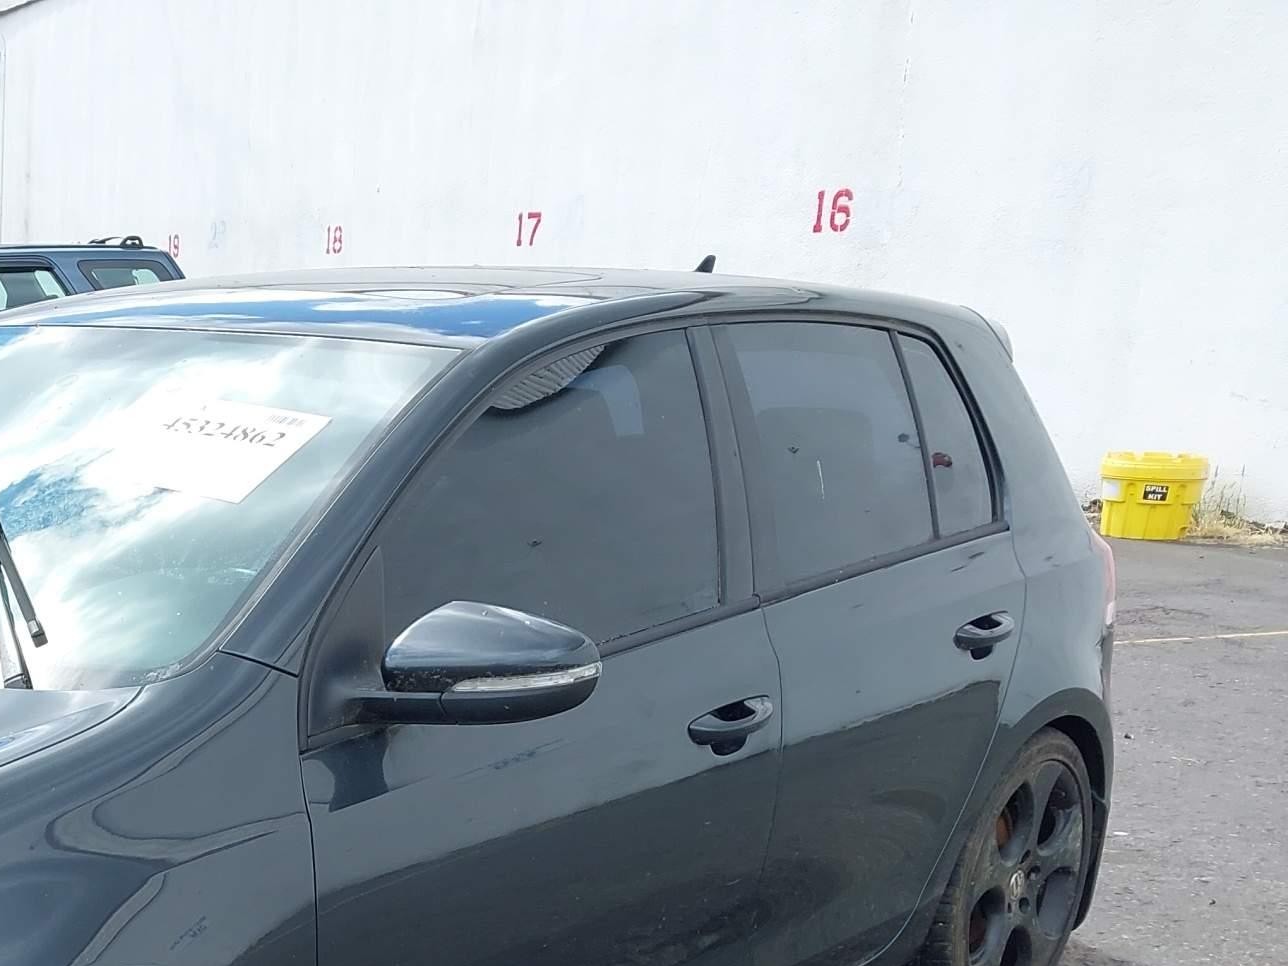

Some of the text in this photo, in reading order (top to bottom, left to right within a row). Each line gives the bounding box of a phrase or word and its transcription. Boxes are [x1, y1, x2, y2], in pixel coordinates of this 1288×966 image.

[813, 188, 853, 232] 16
[325, 225, 343, 254] 18
[516, 212, 542, 247] 17
[168, 234, 180, 258] 19
[1145, 485, 1168, 493] SPILL
